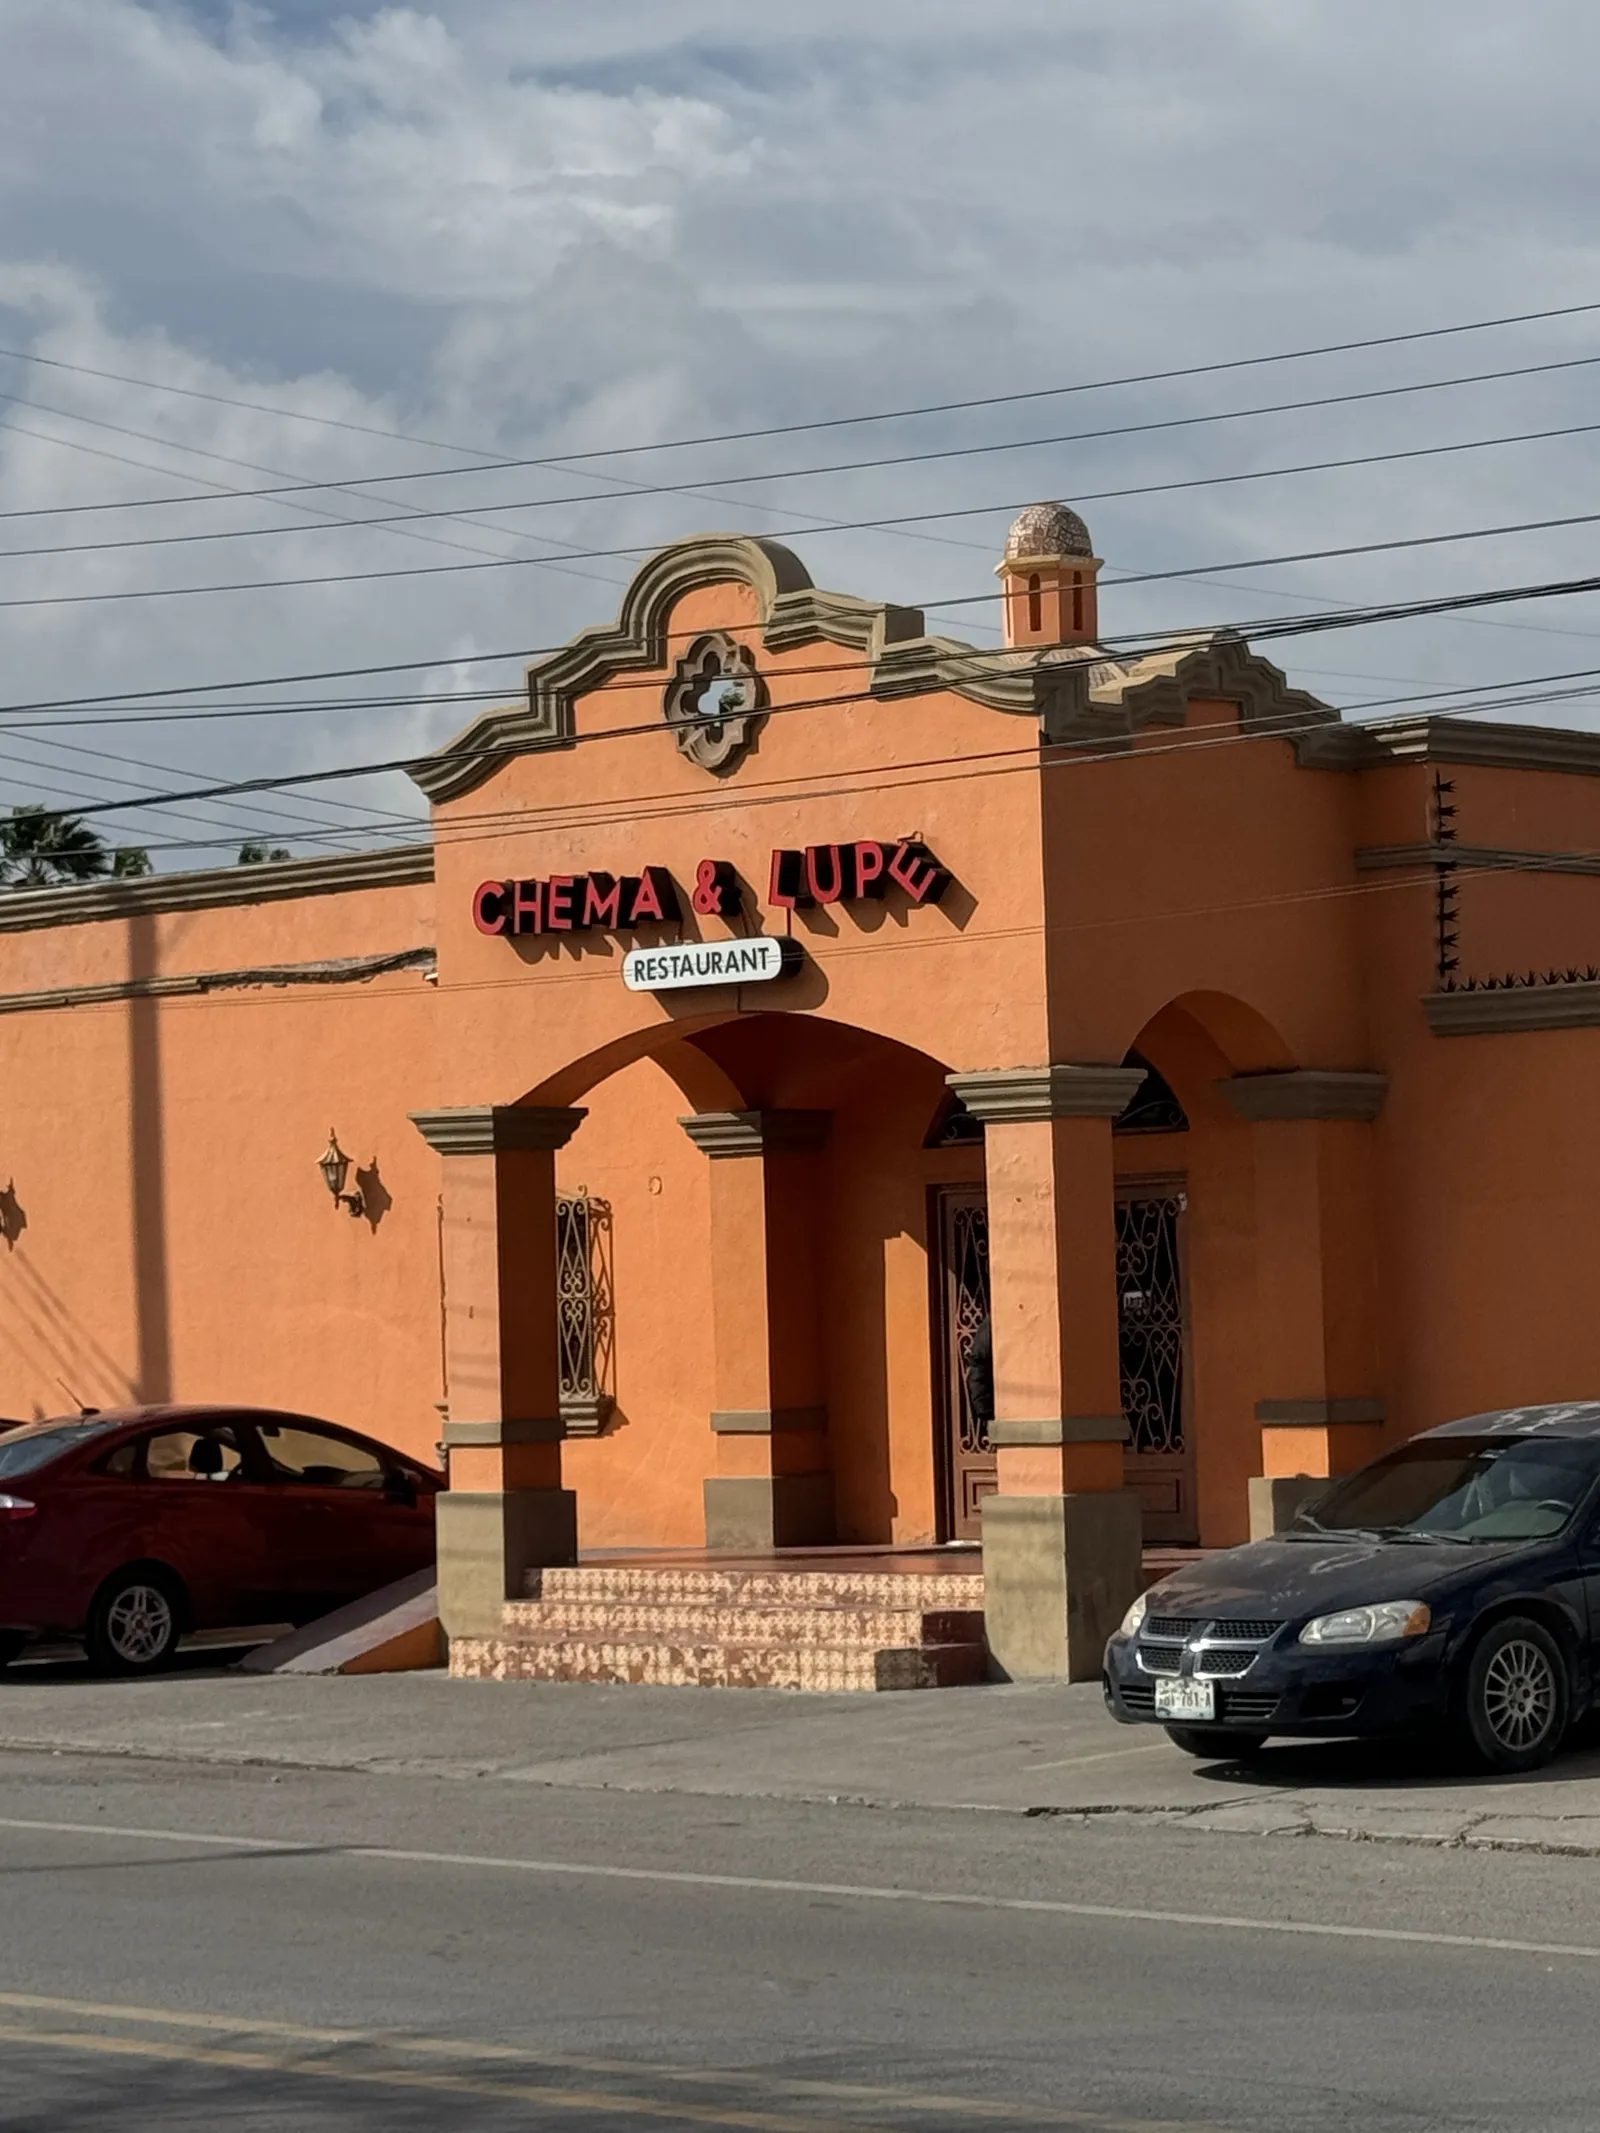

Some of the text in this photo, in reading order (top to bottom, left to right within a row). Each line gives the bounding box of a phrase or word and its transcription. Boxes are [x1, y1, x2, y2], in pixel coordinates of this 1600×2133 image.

[474, 841, 939, 935] CHEMA & LUPE
[633, 946, 770, 983] RESTAURANT
